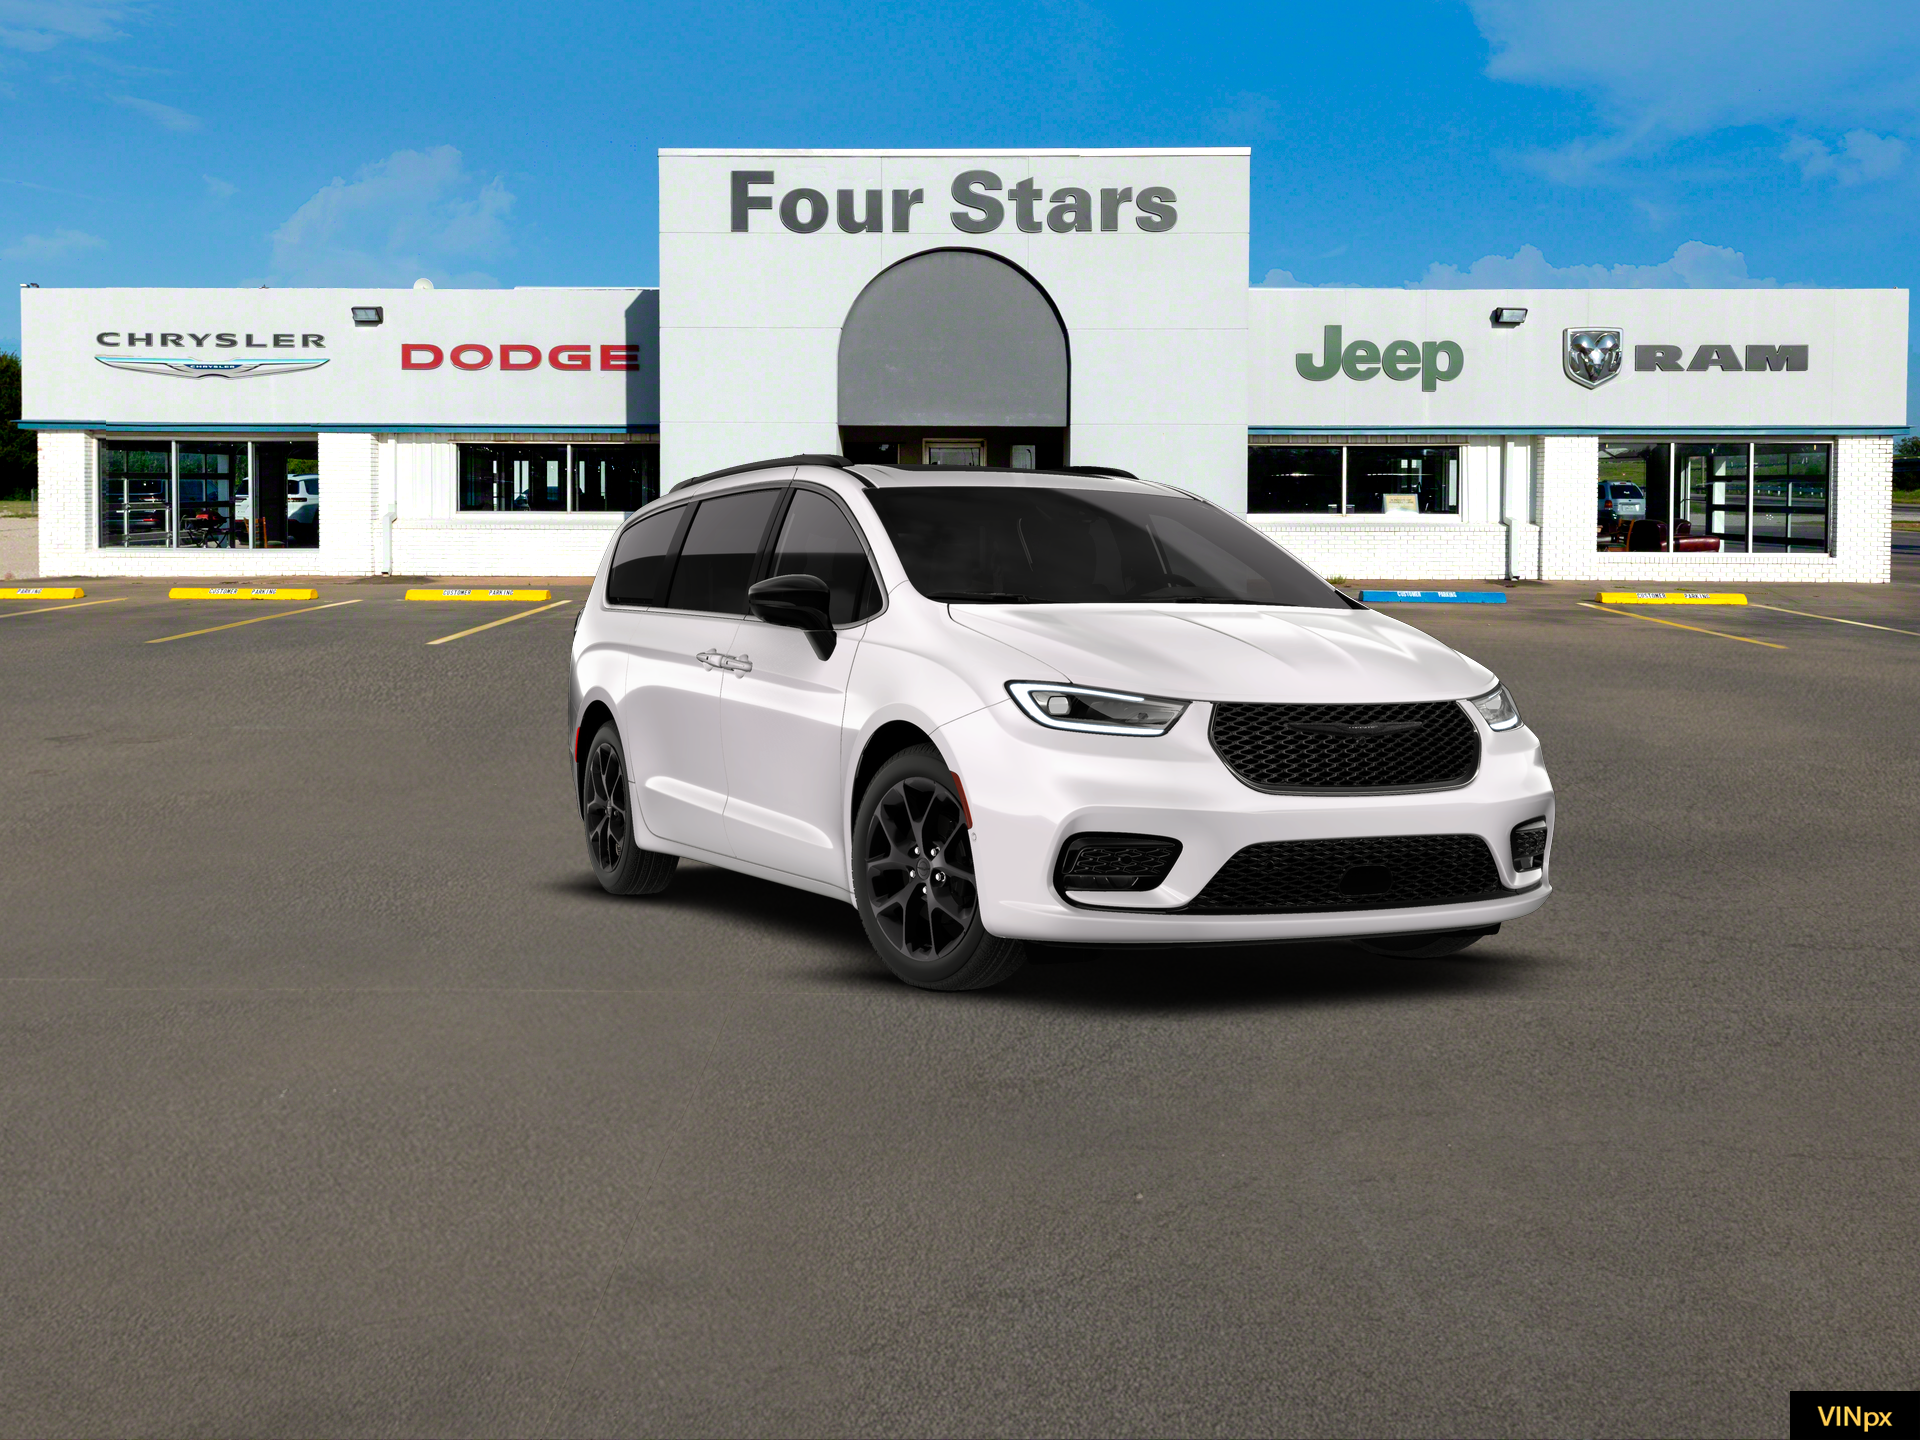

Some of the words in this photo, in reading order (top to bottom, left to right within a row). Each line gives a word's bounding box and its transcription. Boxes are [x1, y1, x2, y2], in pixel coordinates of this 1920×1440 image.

[730, 169, 924, 234] Four
[950, 168, 1178, 235] Stars
[96, 331, 327, 349] CHRYSLER
[401, 342, 641, 372] DODGE
[1295, 324, 1465, 393] Jeep
[1634, 342, 1810, 372] RAM
[16, 587, 43, 595] PARKING
[208, 587, 239, 595] CUSTOMER
[1396, 590, 1422, 598] CUSTOMER
